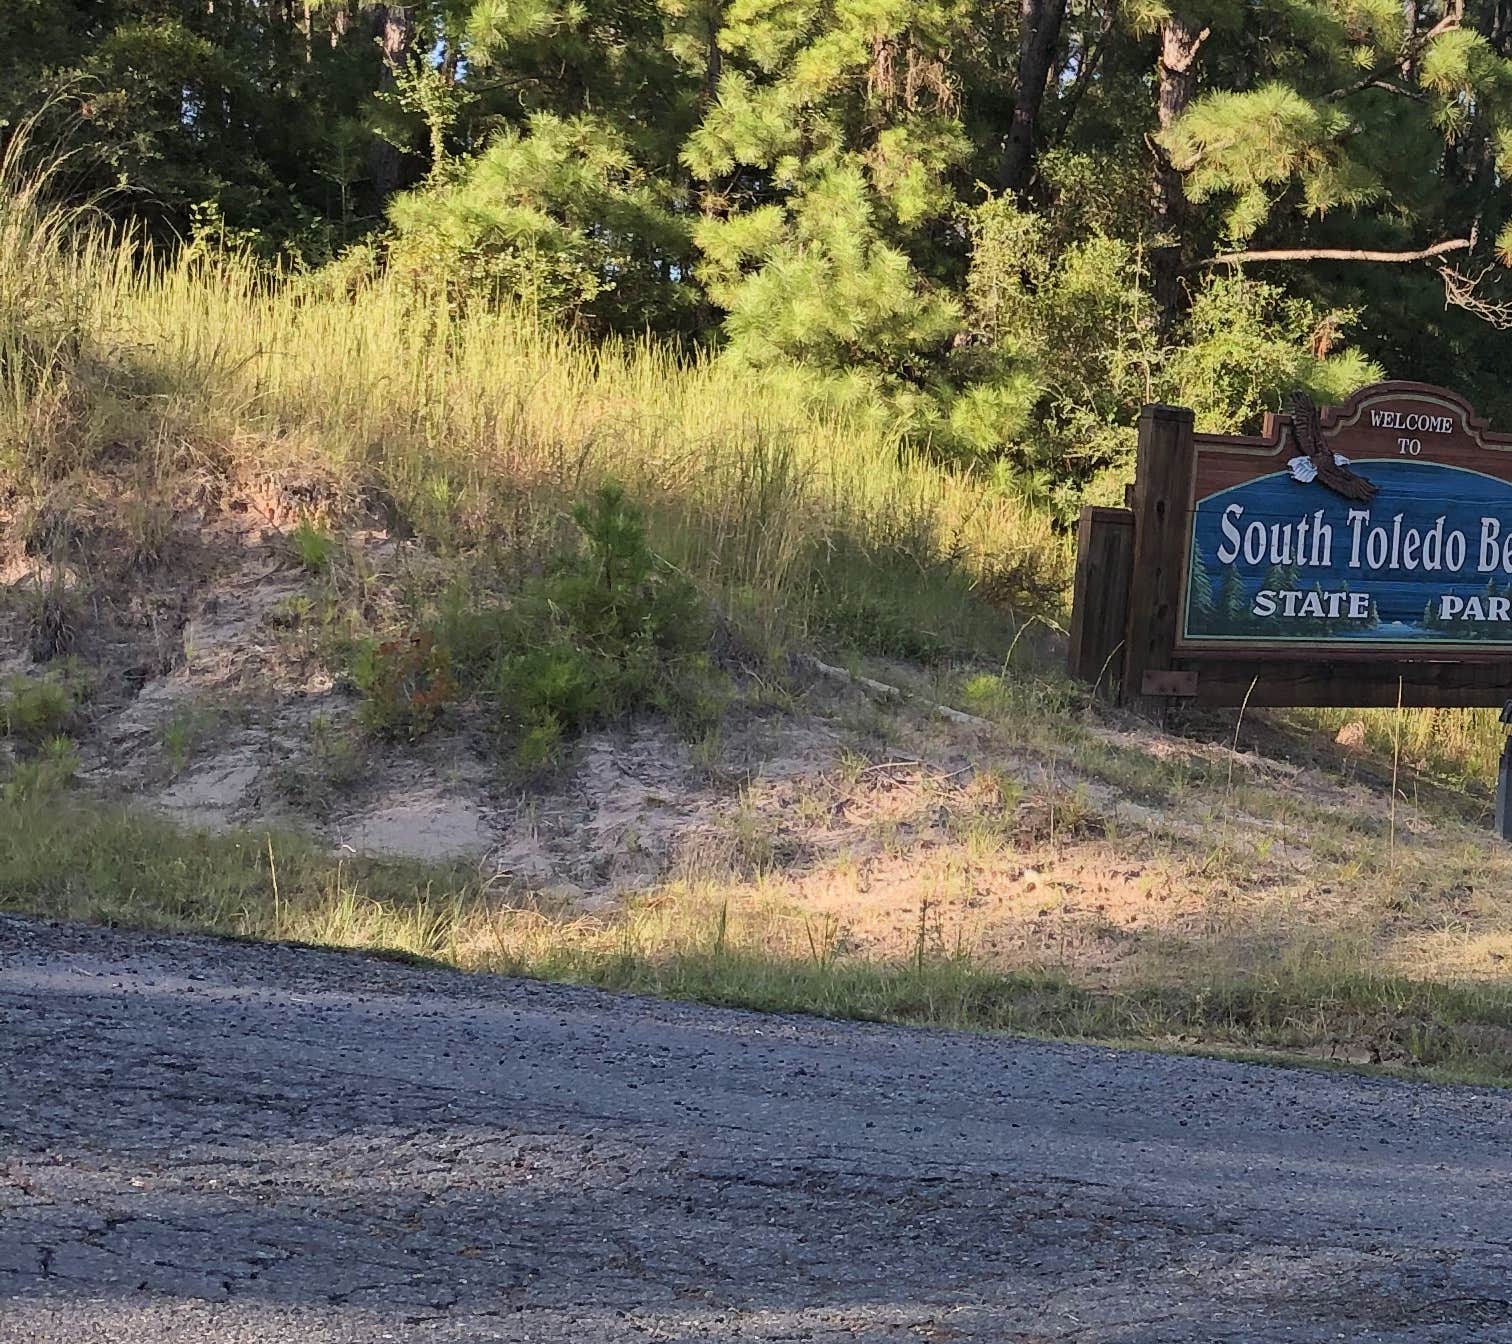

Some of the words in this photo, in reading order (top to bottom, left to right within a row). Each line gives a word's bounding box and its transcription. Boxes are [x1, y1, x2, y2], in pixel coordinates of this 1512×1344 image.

[1370, 409, 1453, 434] WELCOME
[1397, 437, 1421, 456] TO
[1216, 503, 1332, 567] South
[1346, 507, 1466, 573] Toledo
[1252, 589, 1370, 619] STATE
